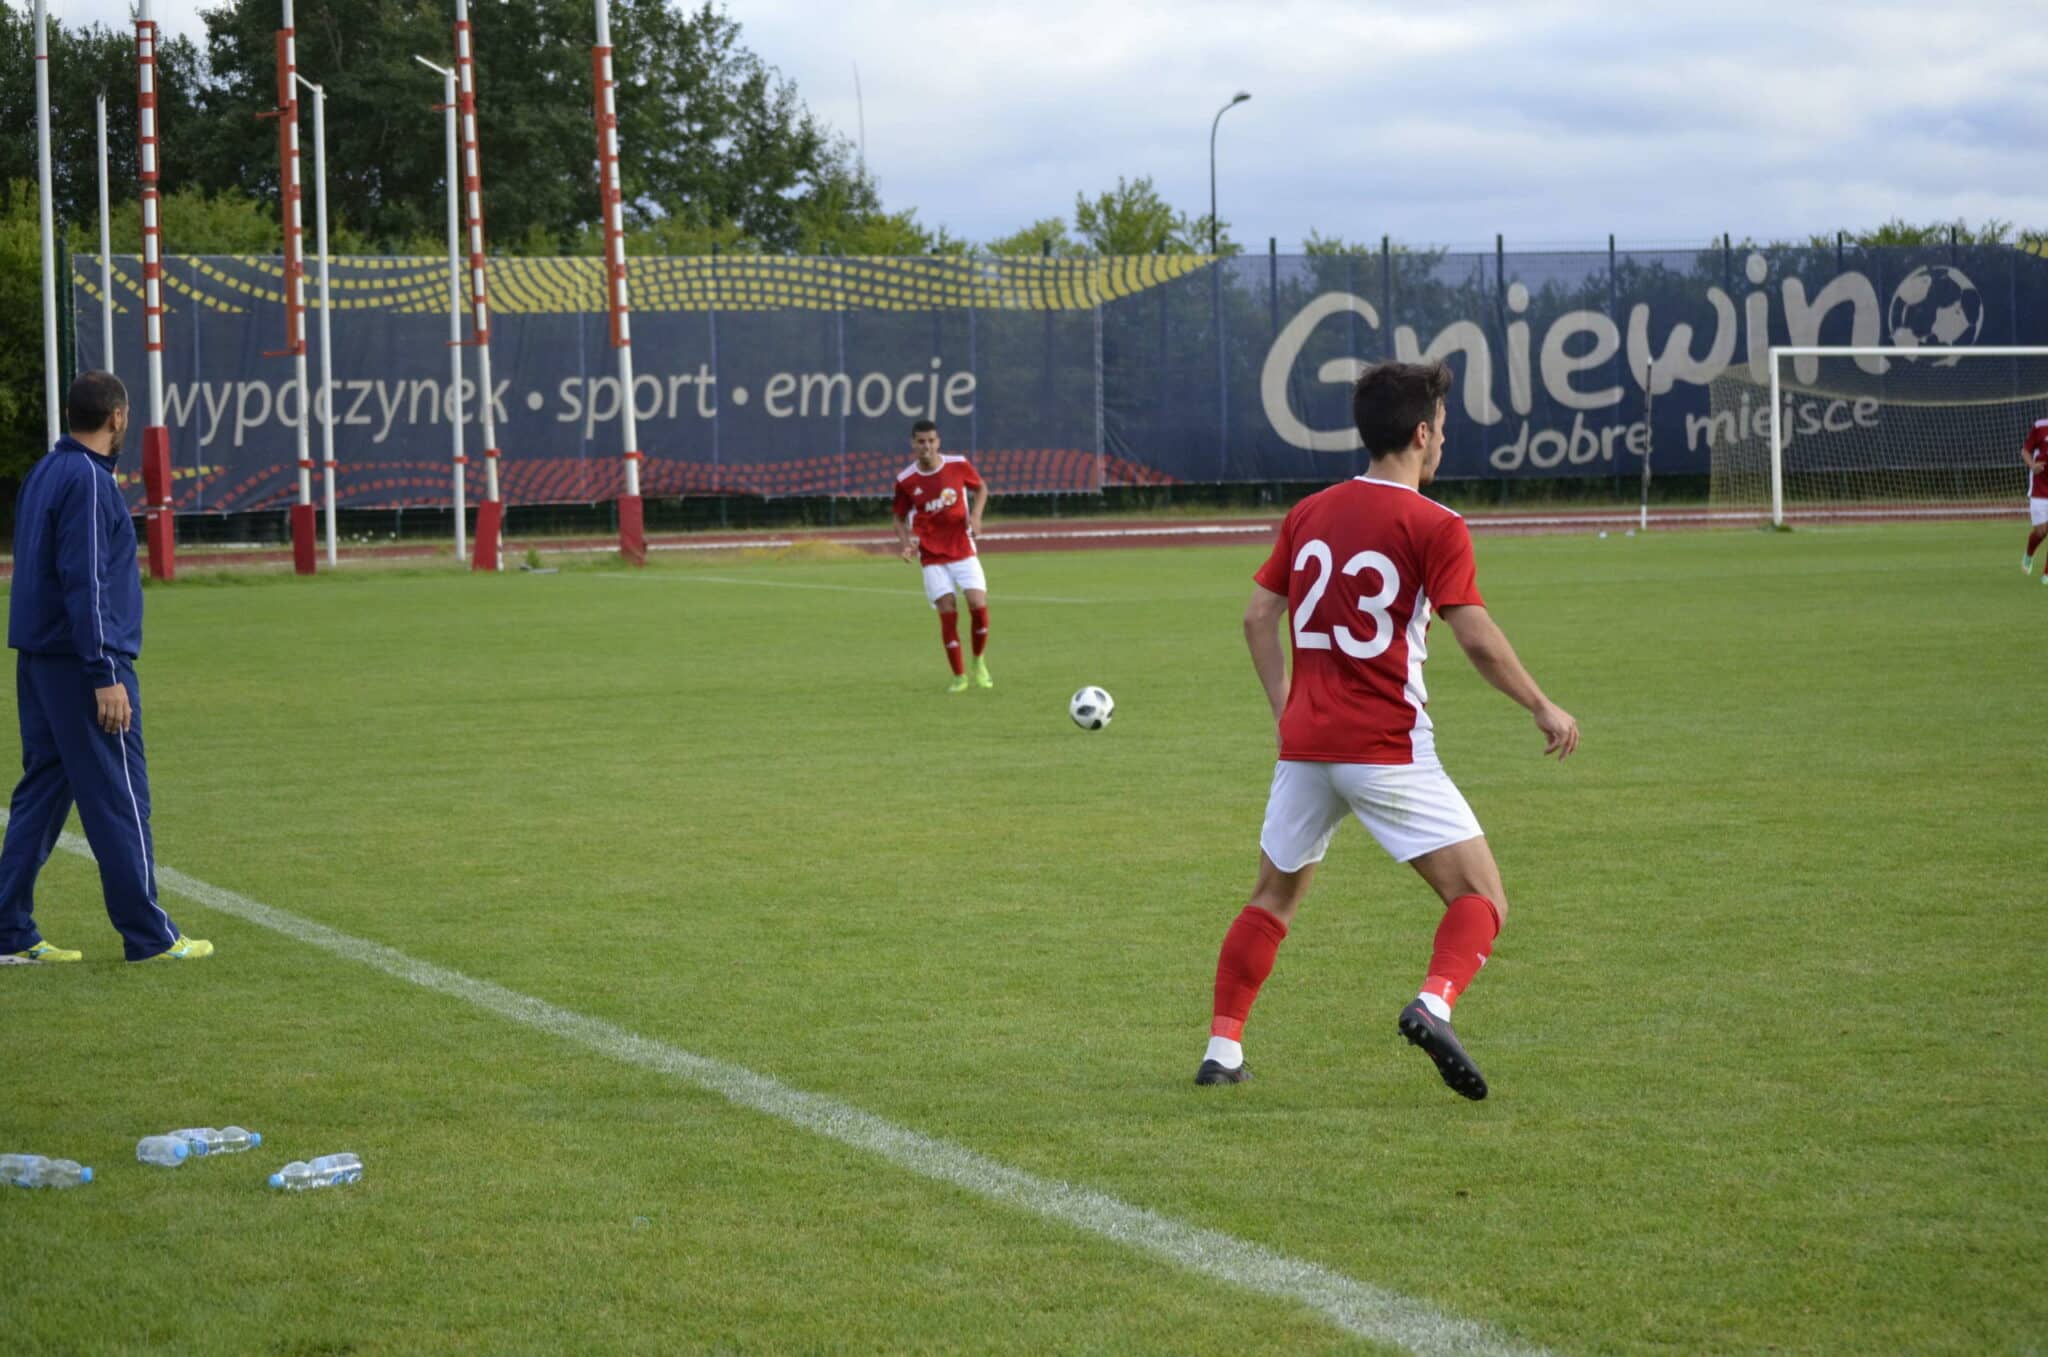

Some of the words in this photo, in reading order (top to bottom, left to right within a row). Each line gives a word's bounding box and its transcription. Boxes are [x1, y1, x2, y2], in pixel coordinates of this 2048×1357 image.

[162, 378, 512, 447] wypoczynek
[556, 363, 718, 441] sport
[764, 356, 977, 422] emocje
[1490, 411, 1654, 471] dobre
[1686, 392, 1880, 452] miejsce
[1293, 538, 1401, 660] 23
